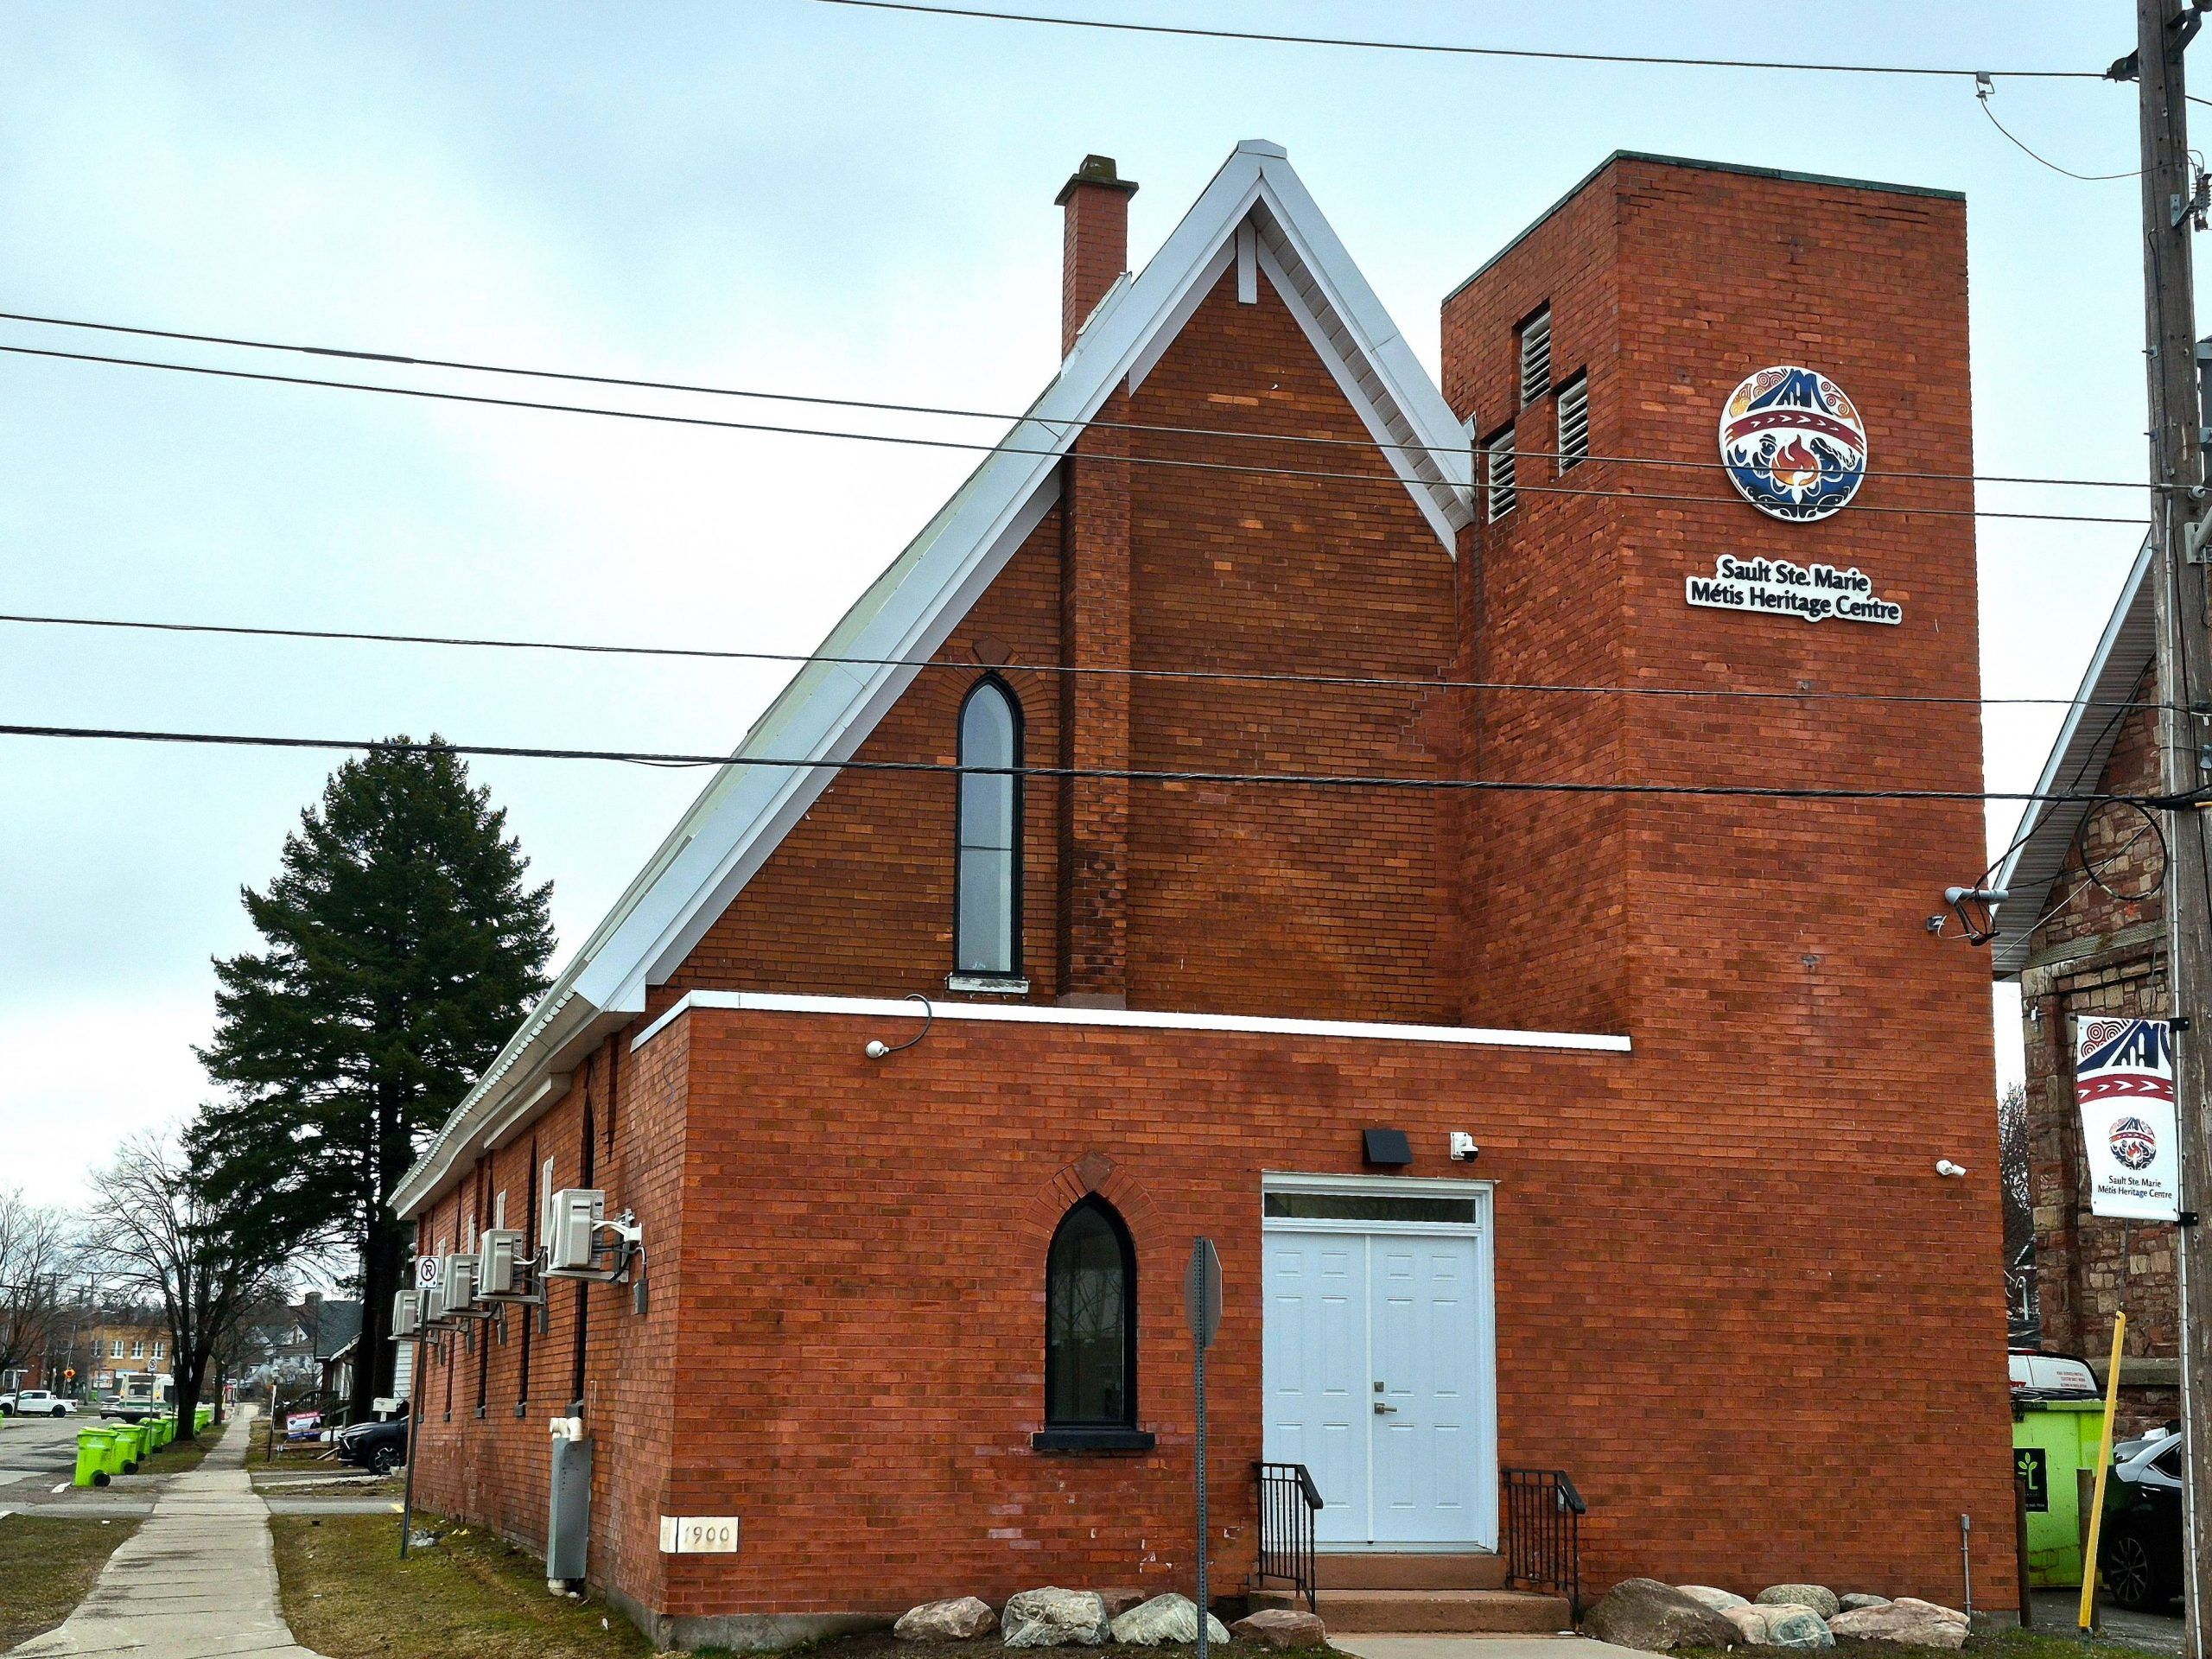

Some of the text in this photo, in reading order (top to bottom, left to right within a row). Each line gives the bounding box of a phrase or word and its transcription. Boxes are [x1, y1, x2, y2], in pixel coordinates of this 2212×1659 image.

[1722, 558, 1869, 592] Sault Ste. Marie
[1691, 581, 1899, 620] Métis Heritage Centre
[2108, 1175, 2162, 1187] Sault Ste. Marie
[2097, 1185, 2173, 1199] Métis Heritage Centre
[684, 1526, 729, 1544] 1900
